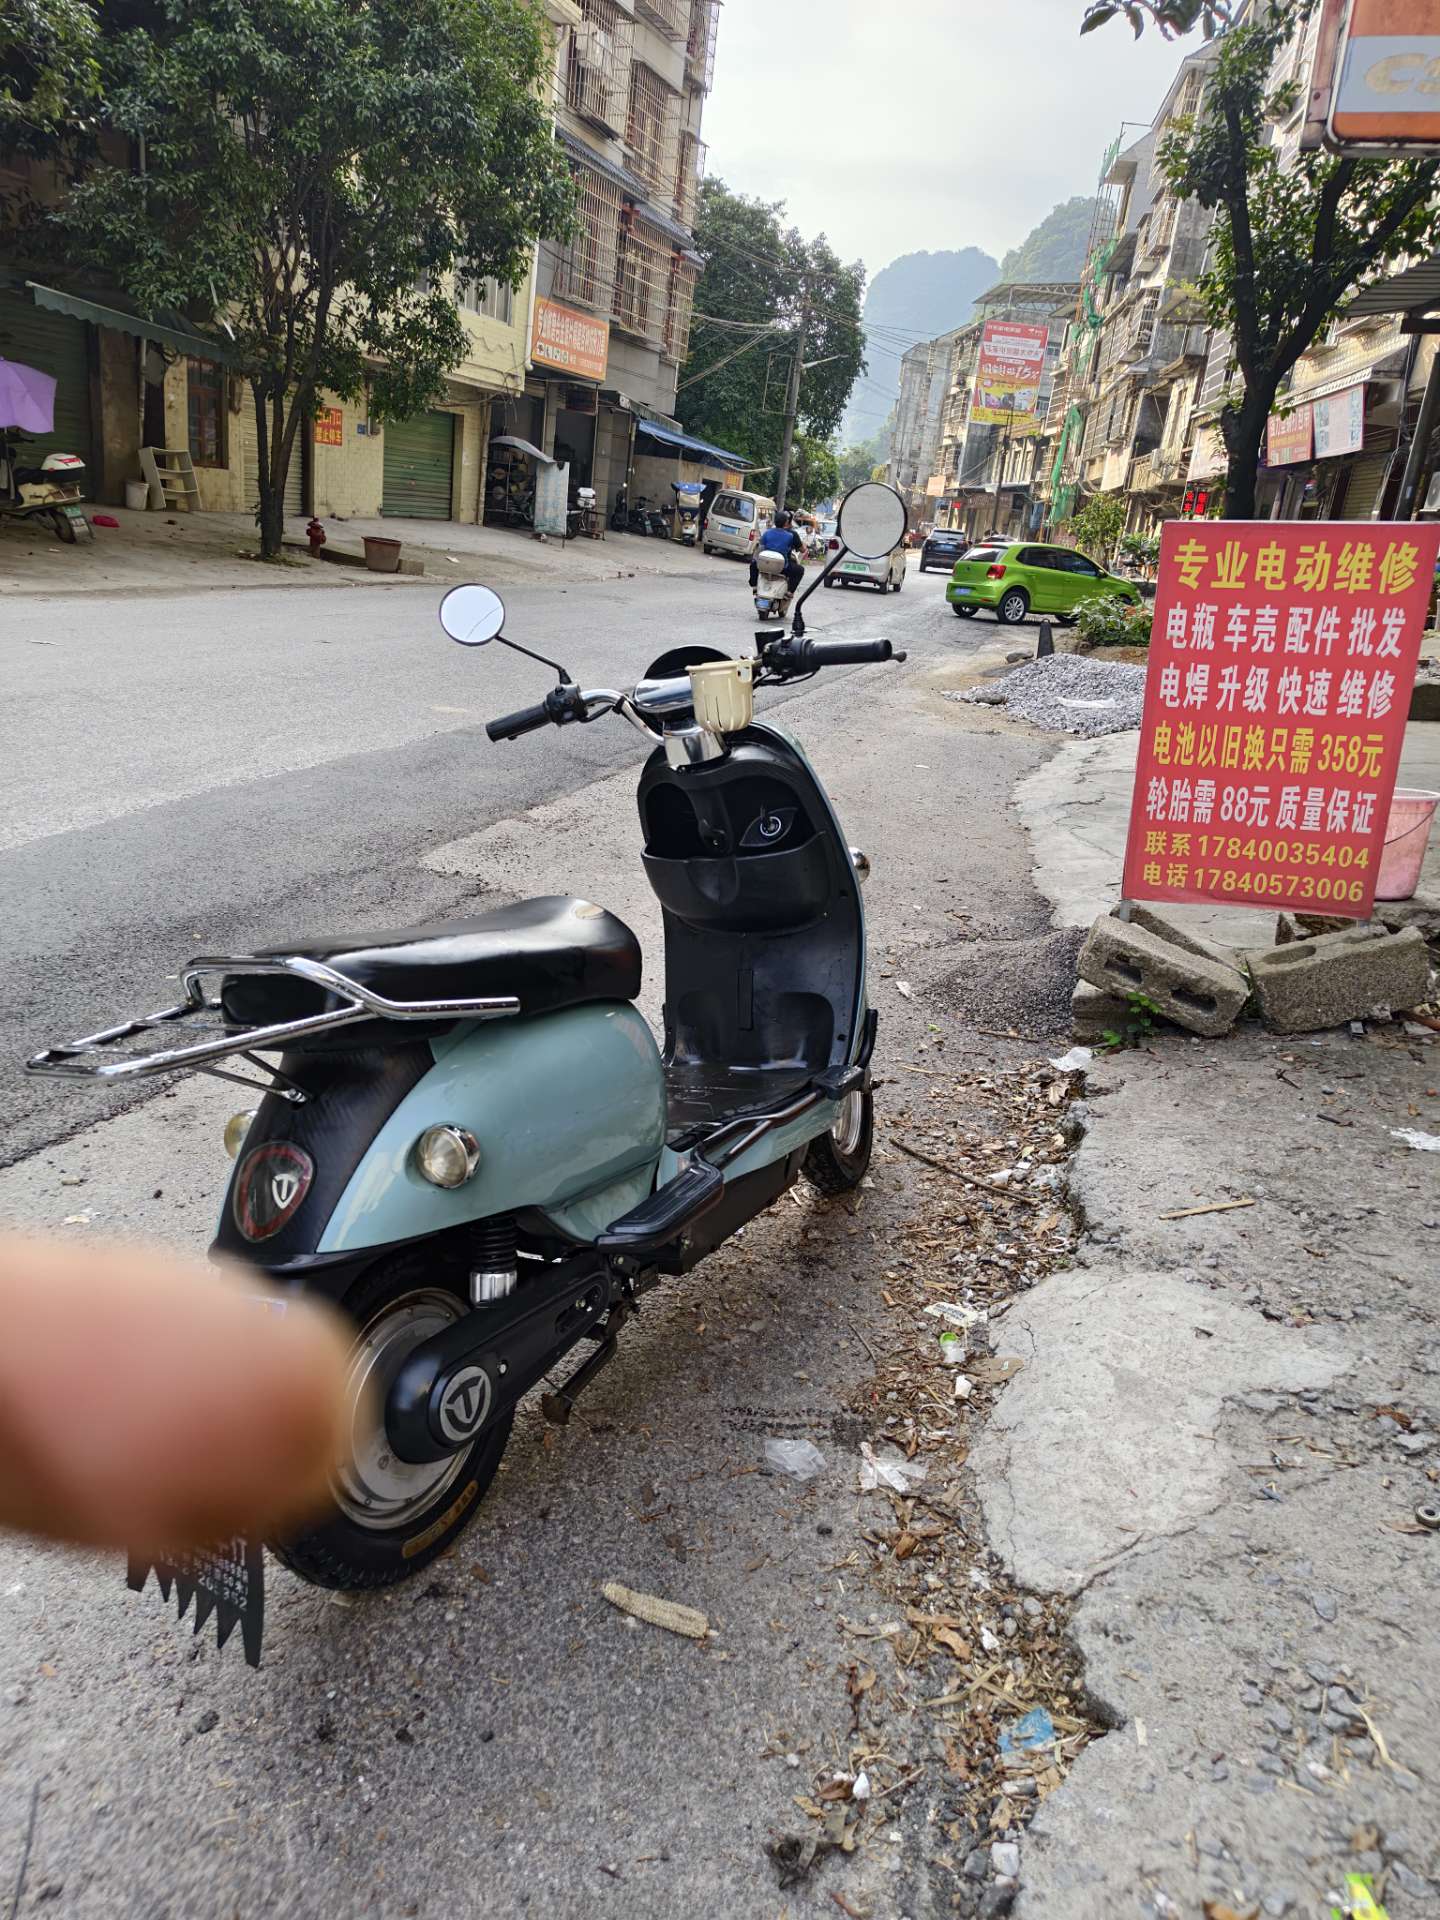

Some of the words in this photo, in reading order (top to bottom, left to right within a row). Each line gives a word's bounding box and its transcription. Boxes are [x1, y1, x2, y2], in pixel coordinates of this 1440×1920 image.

[1173, 538, 1419, 595] 专业电动维修
